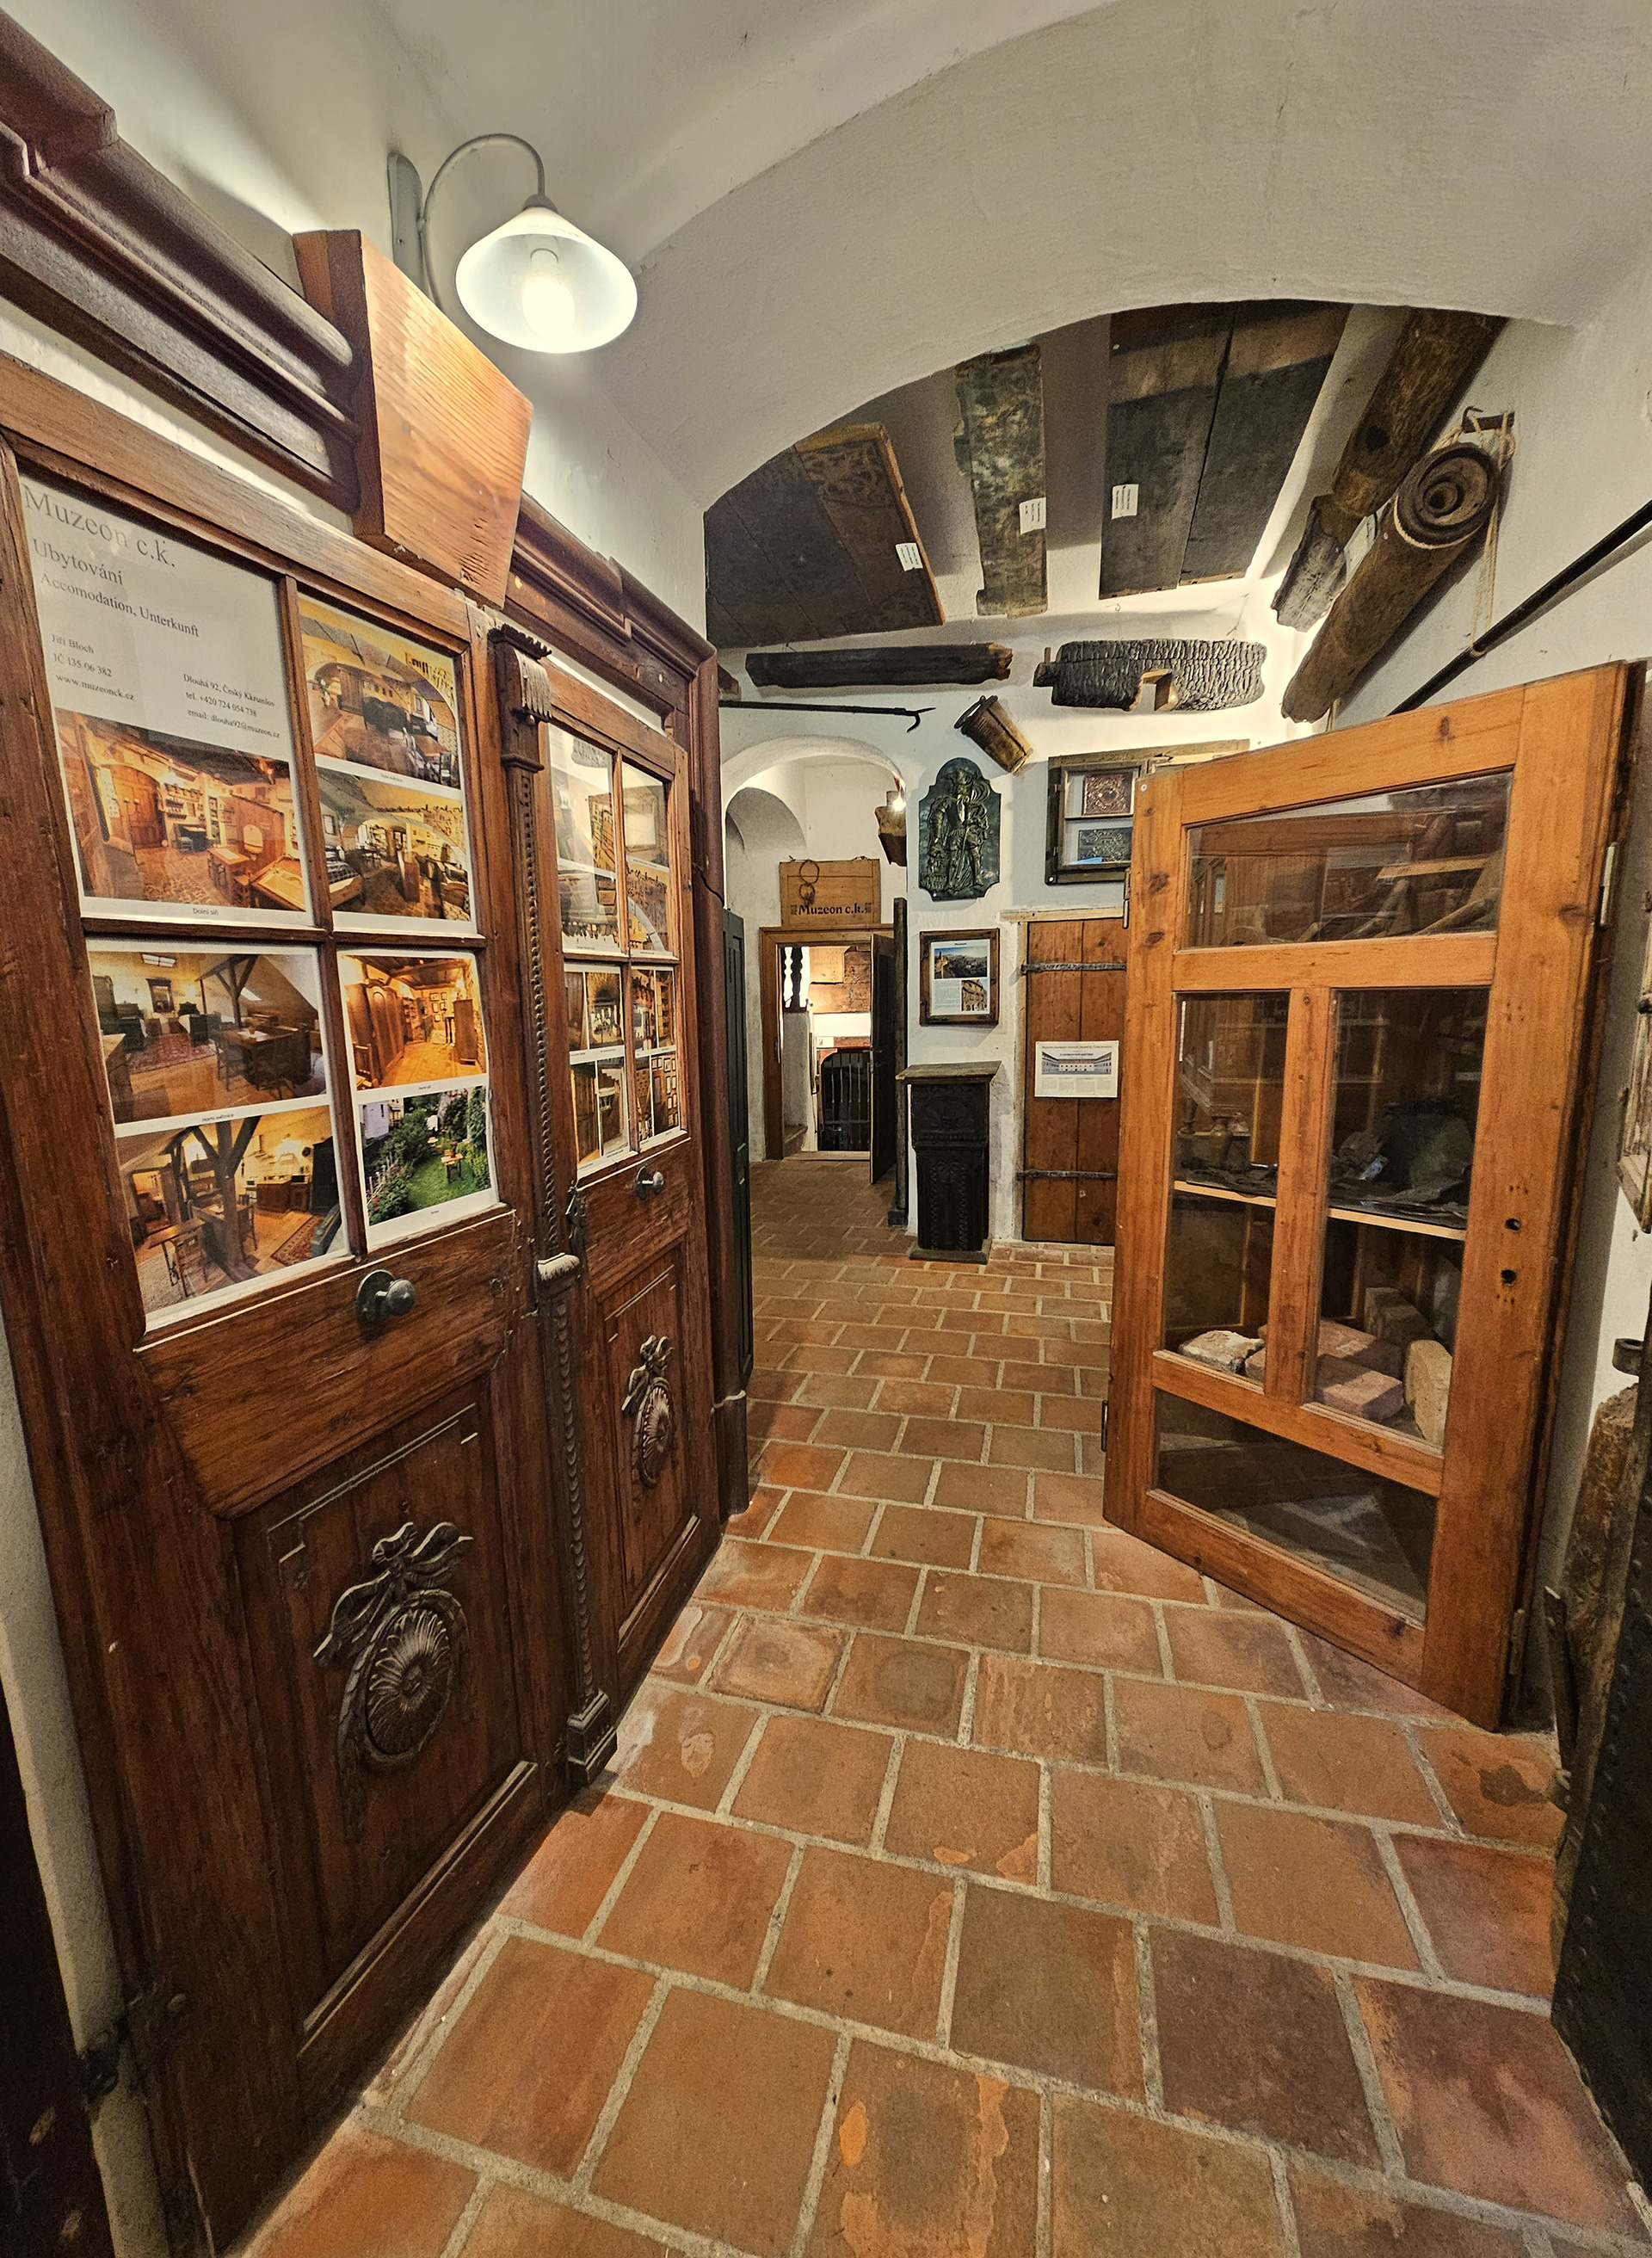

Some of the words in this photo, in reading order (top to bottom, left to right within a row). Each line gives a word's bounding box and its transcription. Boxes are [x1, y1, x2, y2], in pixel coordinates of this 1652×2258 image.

[22, 484, 128, 548] Muzeon
[136, 539, 176, 568] c.k.
[32, 538, 124, 586] Ubytování
[40, 573, 137, 617] Accomodation,
[139, 605, 200, 638] Unterkunft
[69, 639, 95, 654] Bloch
[96, 665, 113, 677] 382
[200, 696, 217, 706] +420
[218, 699, 231, 709] 724
[798, 904, 842, 915] Muzeon
